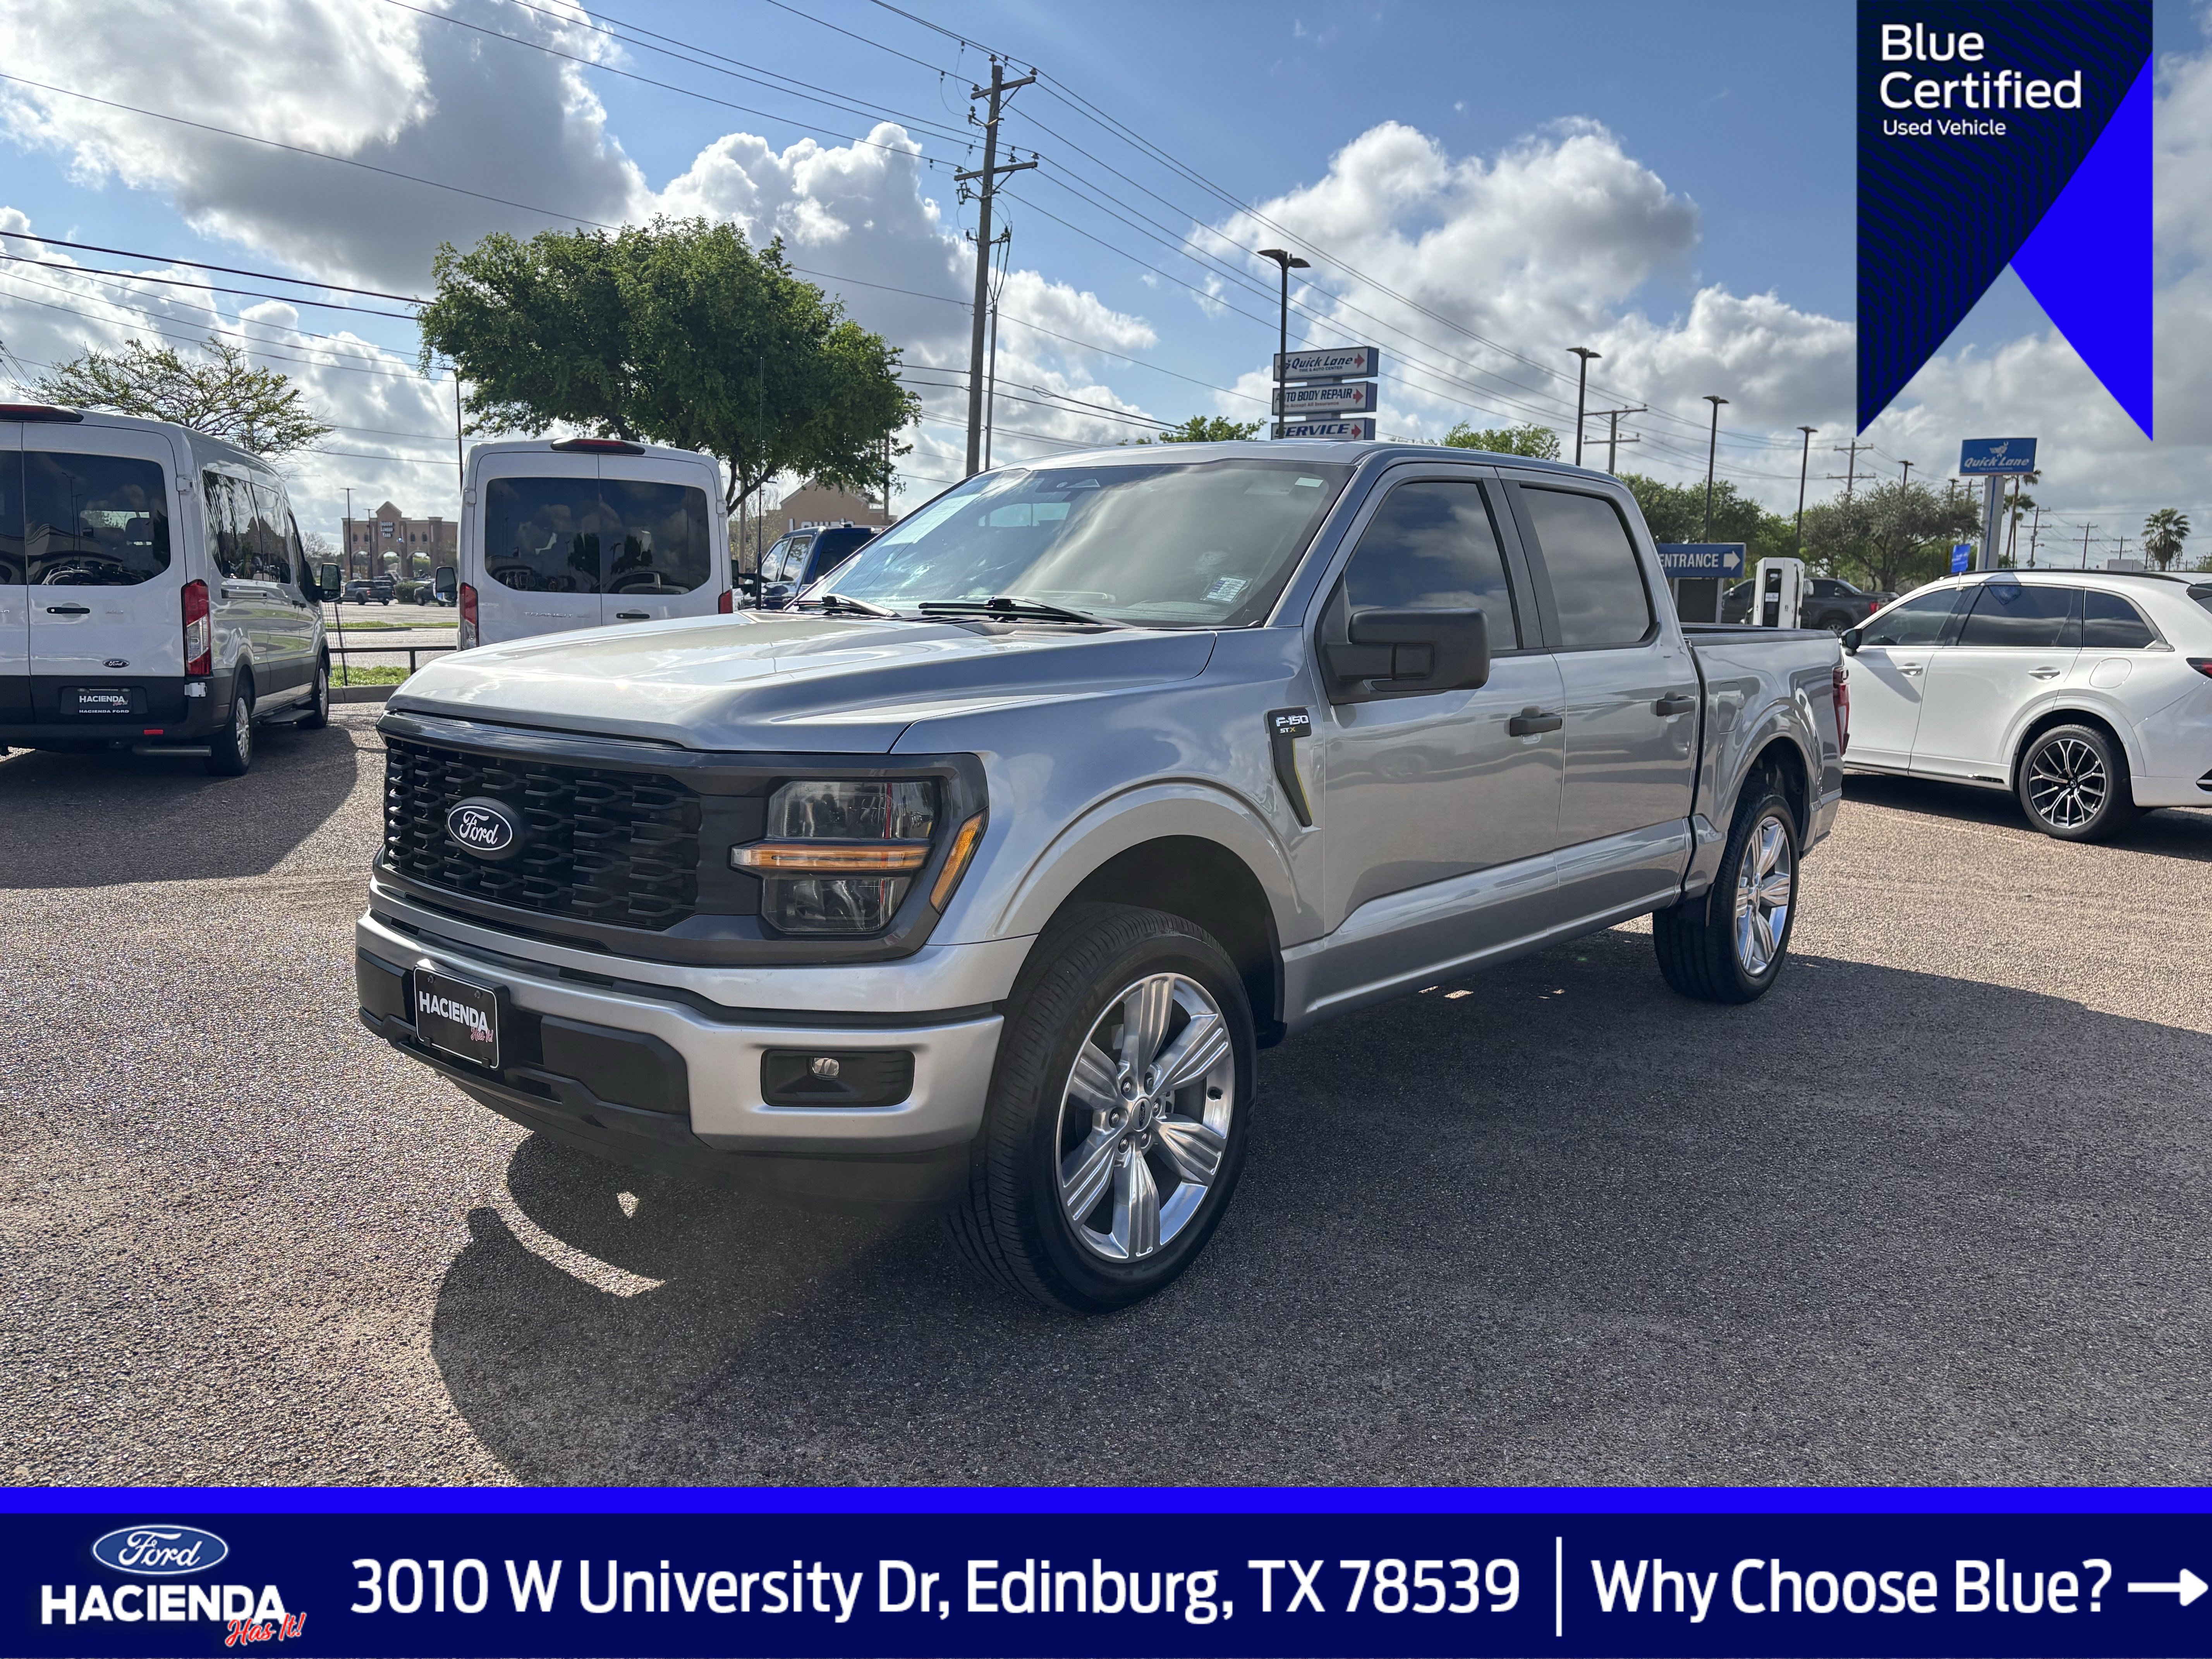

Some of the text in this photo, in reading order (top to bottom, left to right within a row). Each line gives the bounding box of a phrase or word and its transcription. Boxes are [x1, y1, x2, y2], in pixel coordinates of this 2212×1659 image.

[1292, 356, 1353, 369] Quick Lane
[1298, 390, 1320, 401] BODY
[1321, 388, 1352, 400] REPAIR
[1964, 457, 2029, 468] Quick Lane
[1659, 553, 1719, 568] ENTRANCE
[1275, 715, 1309, 726] F-150
[459, 811, 500, 845] Ford
[419, 991, 489, 1032] HACIENDA
